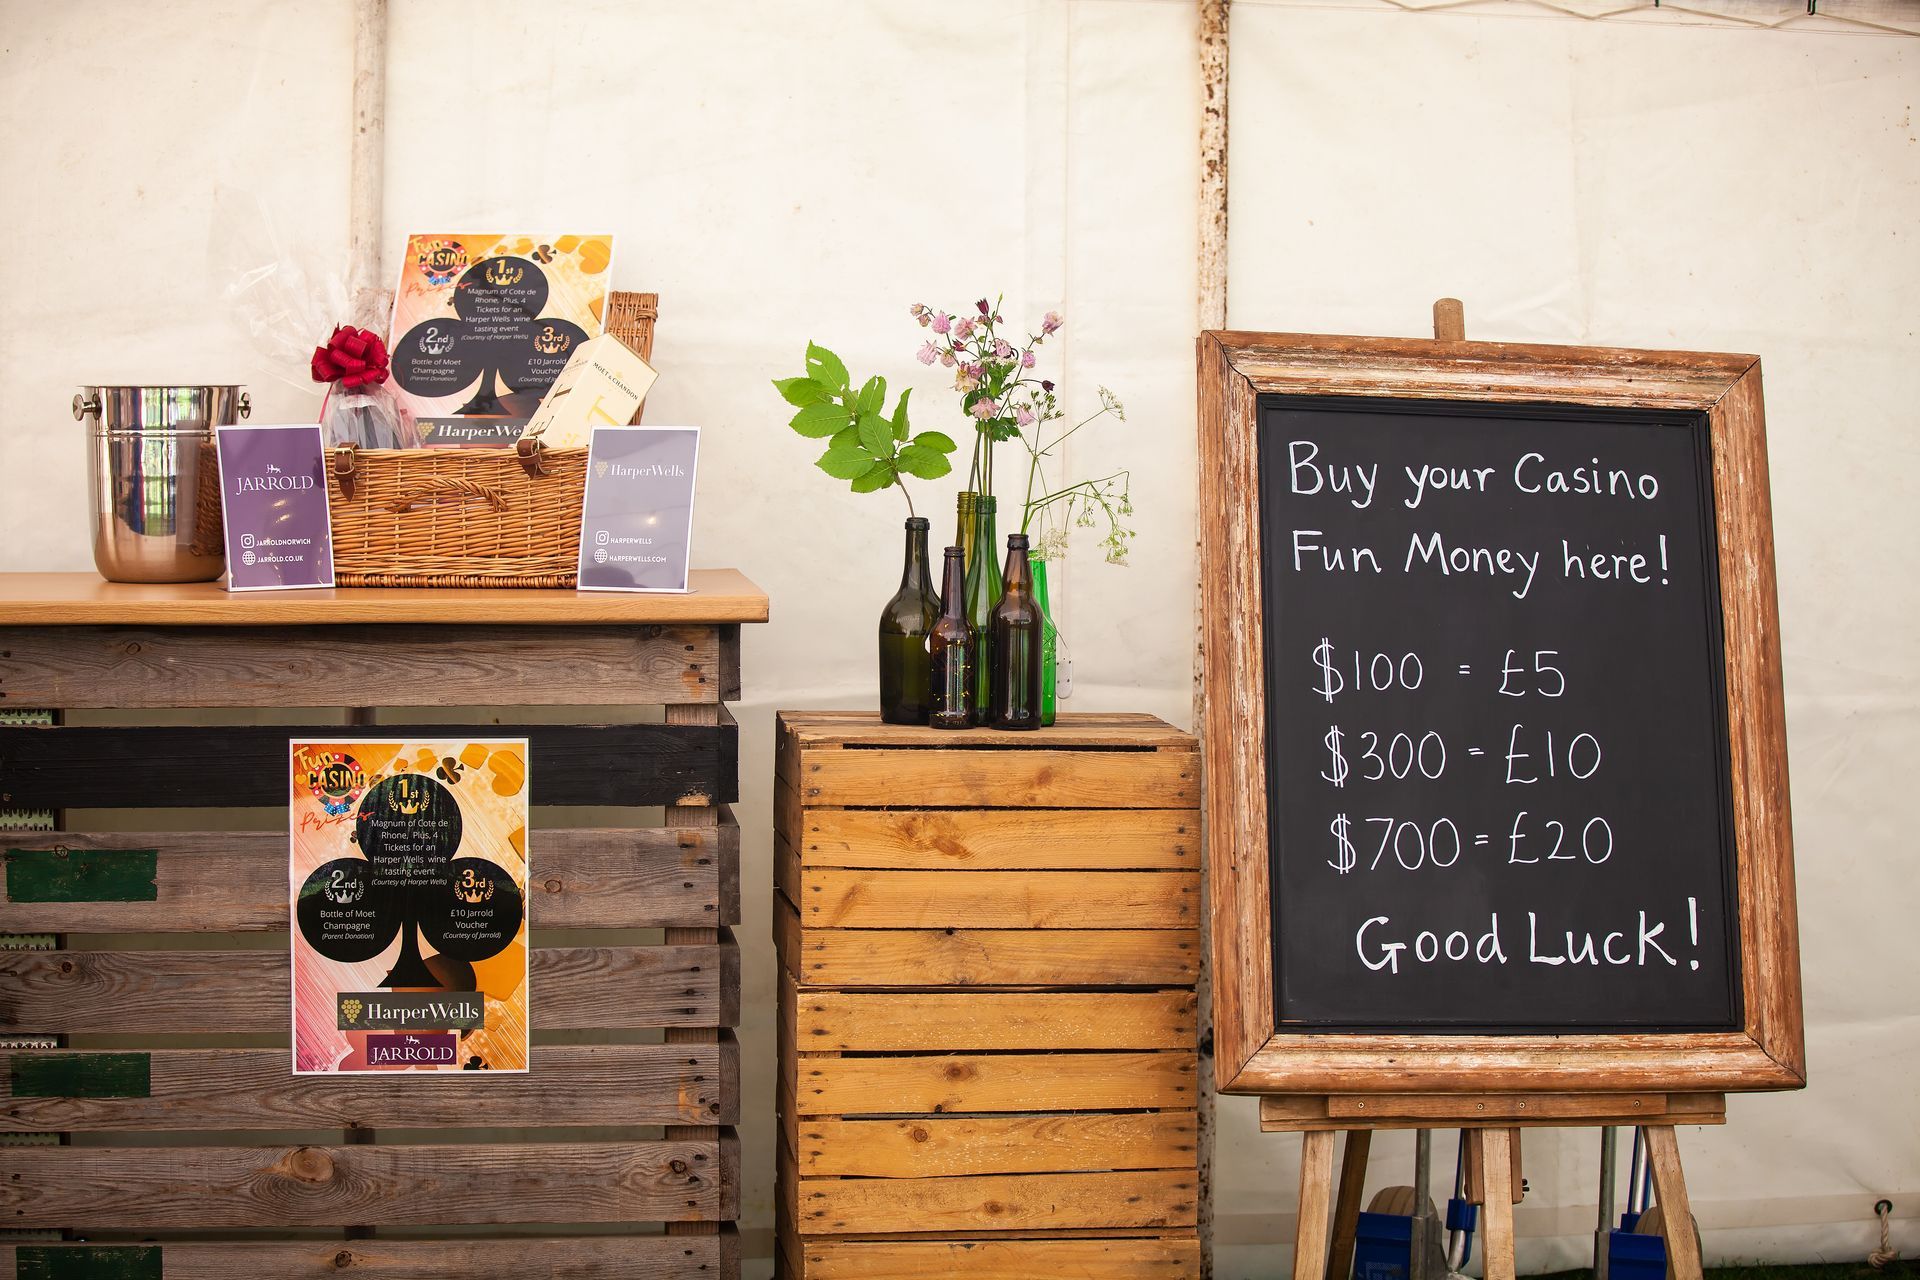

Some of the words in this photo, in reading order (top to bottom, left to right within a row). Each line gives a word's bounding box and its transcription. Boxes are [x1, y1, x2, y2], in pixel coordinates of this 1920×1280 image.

[418, 252, 470, 266] CASINO
[496, 259, 514, 274] 1st
[467, 288, 498, 296] Magnum
[465, 316, 490, 324] Harper
[425, 327, 449, 343] 2nd
[541, 326, 563, 342] 3rd
[542, 358, 567, 366] Jarrold
[412, 367, 455, 376] Champagne
[612, 377, 639, 400] CHANDON
[610, 464, 685, 480] HarperWells
[1288, 440, 1378, 509] Buy
[1403, 463, 1496, 509] your
[1513, 452, 1659, 500] Casino
[236, 475, 314, 495] JARROLD
[256, 538, 311, 547] JARROLDNORWICH
[610, 537, 652, 545] HARPERWELLS
[257, 555, 304, 564] JARROLD.CO.UK
[609, 555, 667, 563] HARPERWELLS.COM
[1291, 529, 1383, 573] Fun
[1404, 532, 1540, 599] Money
[1561, 534, 1670, 586] here!
[1312, 636, 1424, 704] $100
[1498, 648, 1566, 698] £5
[293, 746, 334, 772] Fun
[1320, 725, 1446, 789] $300
[1505, 723, 1601, 784] £10
[307, 770, 367, 791] CASINO
[398, 778, 420, 799] 1st
[299, 810, 376, 834] Prizes
[371, 819, 406, 830] Magnum
[407, 819, 417, 828] of
[418, 819, 436, 828] Cote
[437, 819, 449, 828] de
[381, 831, 409, 841] Rhone,
[413, 831, 432, 841] Plus,
[1327, 813, 1461, 875] $700
[1507, 811, 1613, 865] £20
[384, 843, 411, 852] Tickets
[413, 843, 424, 852] for
[425, 844, 436, 852] an
[373, 855, 401, 866] Harper
[403, 854, 424, 864] Wells
[427, 855, 447, 864] wine
[331, 869, 357, 889] 2nd
[384, 867, 412, 877] tasting
[413, 868, 435, 876] event
[462, 869, 486, 889] 3rd
[371, 878, 400, 887] (Courtesy
[400, 878, 408, 887] of
[408, 878, 430, 887] Harper
[430, 878, 448, 887] Wells)
[320, 910, 343, 918] Bottle
[345, 909, 354, 918] of
[355, 910, 376, 918] Moet
[450, 909, 466, 918] £10
[466, 909, 494, 918] Jarrold
[323, 921, 370, 931] Champagne
[455, 921, 489, 930] Voucher
[321, 932, 343, 941] (Parent
[344, 932, 375, 941] Donation)
[442, 931, 471, 940] (Courtesy
[471, 931, 479, 940] of
[478, 931, 502, 940] Jarrold)
[1355, 912, 1508, 975] Good
[367, 1003, 479, 1024] HarperWells
[371, 1047, 454, 1064] JARROLD
